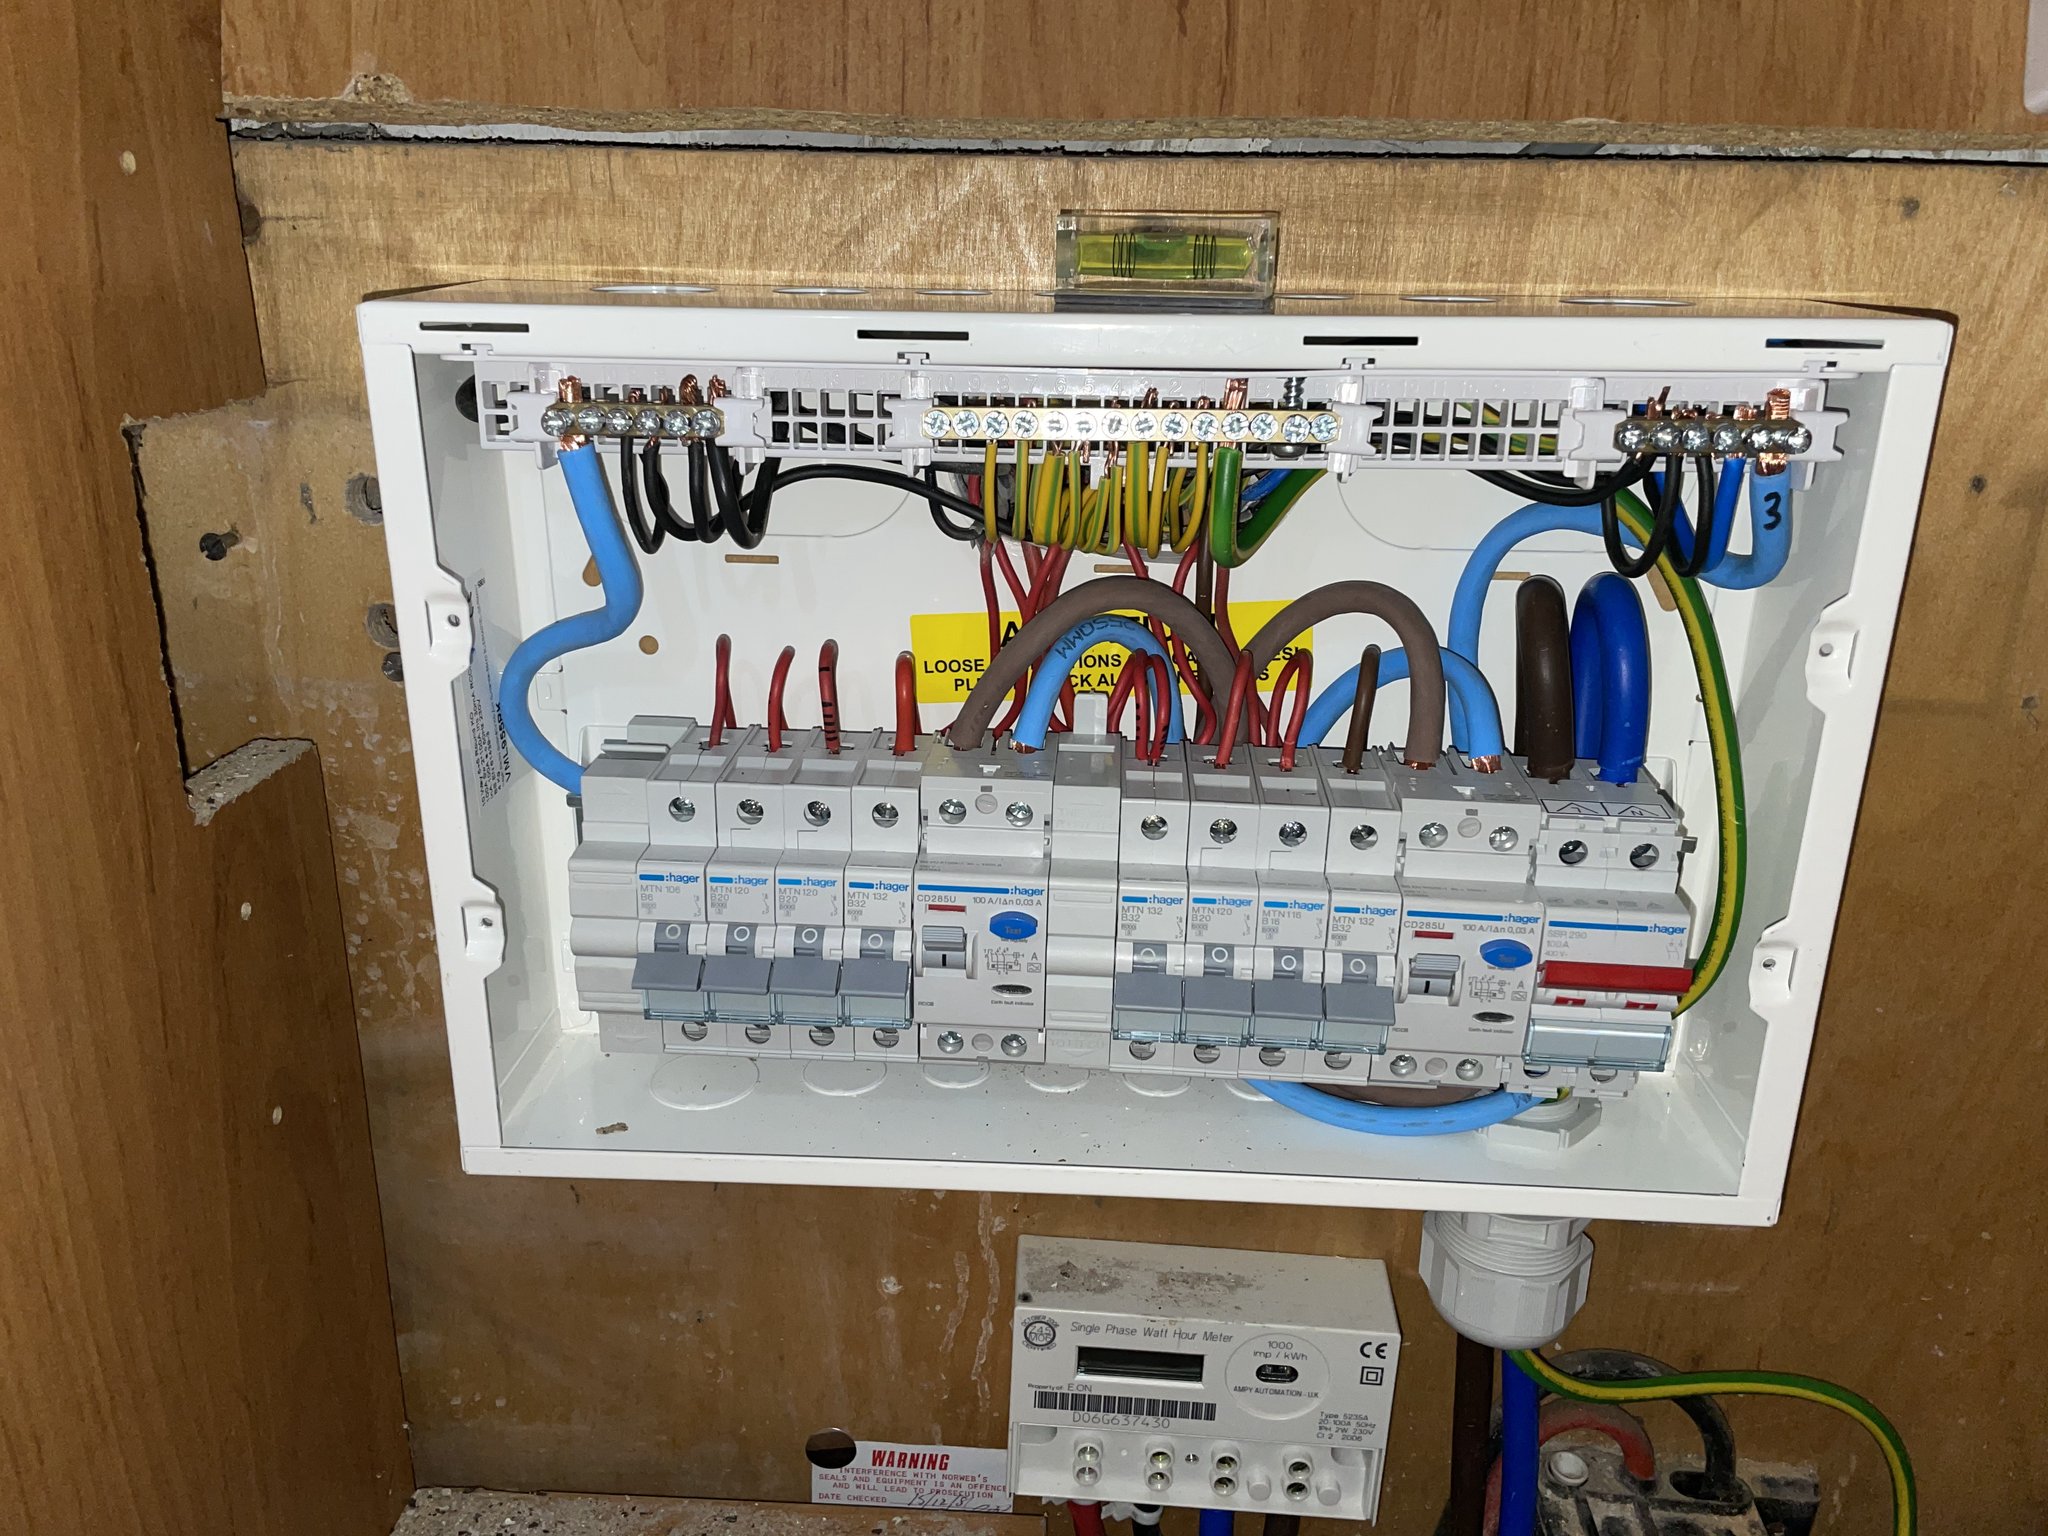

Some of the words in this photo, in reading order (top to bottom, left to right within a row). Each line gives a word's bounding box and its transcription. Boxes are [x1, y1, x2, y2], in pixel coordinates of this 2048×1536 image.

[1763, 491, 1782, 531] 3
[924, 659, 985, 673] LOOSE
[640, 885, 663, 893] MTN
[710, 886, 733, 894] MTN
[847, 892, 870, 900] MTN
[917, 894, 957, 903] CD285U
[1121, 905, 1144, 914] MTN
[1192, 906, 1215, 914] MTN
[1262, 909, 1285, 918] MTN
[1333, 916, 1355, 924] MTN
[1403, 921, 1445, 930] CD285U
[1071, 1322, 1100, 1335] Single
[1105, 1324, 1137, 1337] Phase
[1143, 1327, 1168, 1338] Watt
[1173, 1329, 1197, 1340] Hour
[1202, 1331, 1234, 1343] Meter
[1268, 1341, 1294, 1350] 1000
[1360, 1341, 1388, 1359] CE
[1253, 1350, 1272, 1359] imp
[1284, 1351, 1308, 1361] kWh
[1254, 1387, 1303, 1397] AUTOMATION
[1320, 1411, 1339, 1419] Type
[871, 1449, 950, 1471] WARNING
[839, 1466, 907, 1478] INTERFERENCE
[913, 1470, 937, 1480] WITH
[942, 1473, 988, 1484] NORWEB'S
[818, 1473, 847, 1482] SEALS
[853, 1475, 871, 1484] AND
[876, 1477, 929, 1487] EQUIPMENT
[934, 1480, 944, 1488] IS
[950, 1481, 962, 1489] AN
[967, 1483, 1007, 1493] OFFENCE
[832, 1482, 850, 1490] AND
[855, 1483, 879, 1492] WILL
[884, 1485, 908, 1494] LEAD
[914, 1486, 925, 1495] TO
[930, 1488, 994, 1500] PROSECUTION
[818, 1492, 842, 1501] DATE
[846, 1494, 887, 1504] CHECKED
